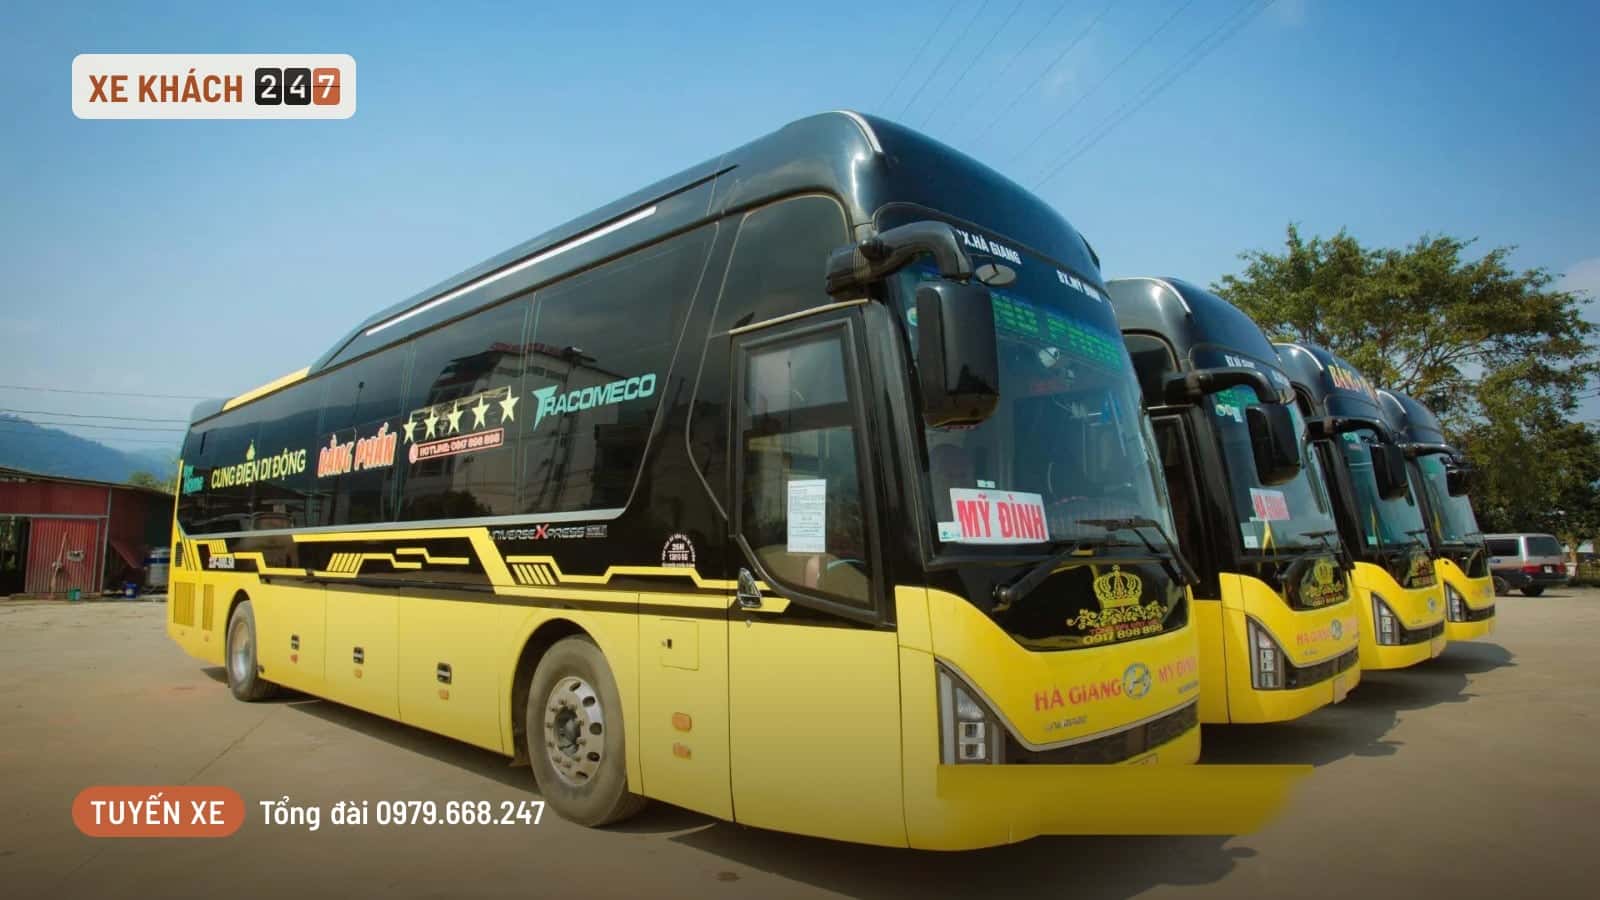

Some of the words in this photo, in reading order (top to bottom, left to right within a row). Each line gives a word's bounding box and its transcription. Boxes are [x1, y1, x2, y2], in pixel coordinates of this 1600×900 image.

[989, 241, 1022, 265] GIANG
[532, 373, 656, 431] TRACOMECO
[211, 465, 236, 489] CUNG
[235, 459, 260, 487] ĐIỆN
[260, 457, 272, 480] DI
[272, 448, 306, 480] ĐỘNG
[957, 493, 991, 538] MỸ
[997, 494, 1046, 540] ĐÌNH
[1082, 632, 1114, 645] 0917
[1034, 684, 1065, 712] HÀ
[1068, 679, 1122, 705] GIANG
